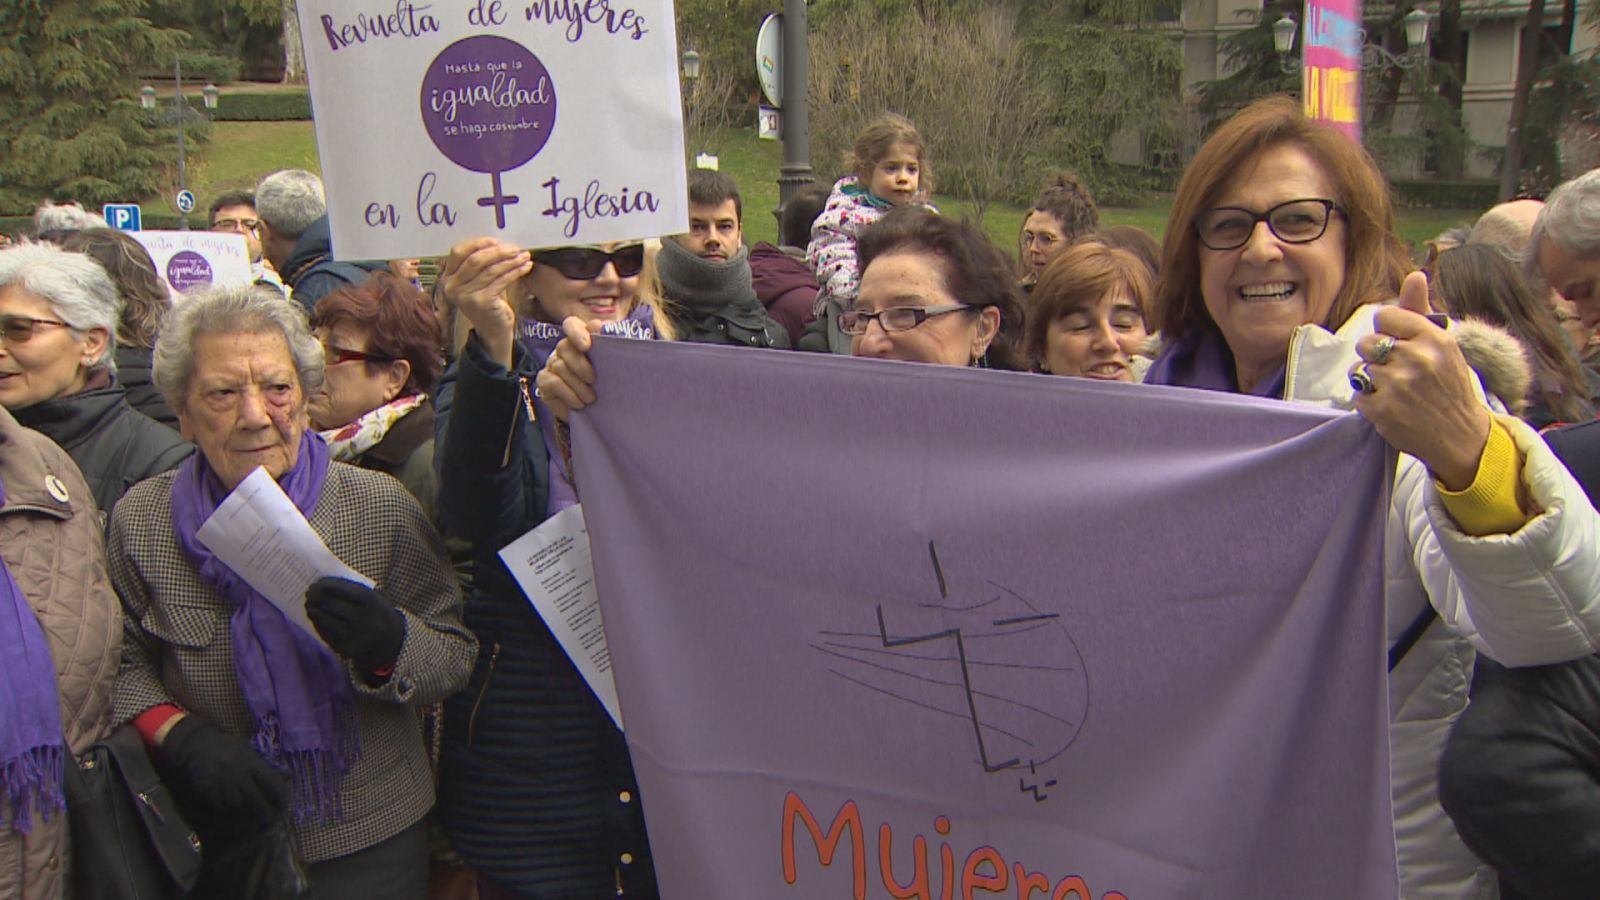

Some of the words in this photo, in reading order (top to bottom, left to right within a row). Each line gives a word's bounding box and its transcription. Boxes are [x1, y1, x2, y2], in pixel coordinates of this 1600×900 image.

[320, 0, 439, 51] Revuelta
[468, 0, 507, 27] de
[525, 0, 649, 43] mujeres
[445, 62, 481, 75] Hasta
[487, 61, 508, 75] que
[512, 60, 523, 70] la
[431, 70, 550, 122] igualdad
[444, 125, 459, 136] se
[460, 121, 488, 139] haga
[489, 117, 540, 132] costumbre
[116, 208, 130, 229] P
[364, 201, 401, 229] en
[416, 172, 458, 227] la
[541, 176, 660, 239] Iglesia
